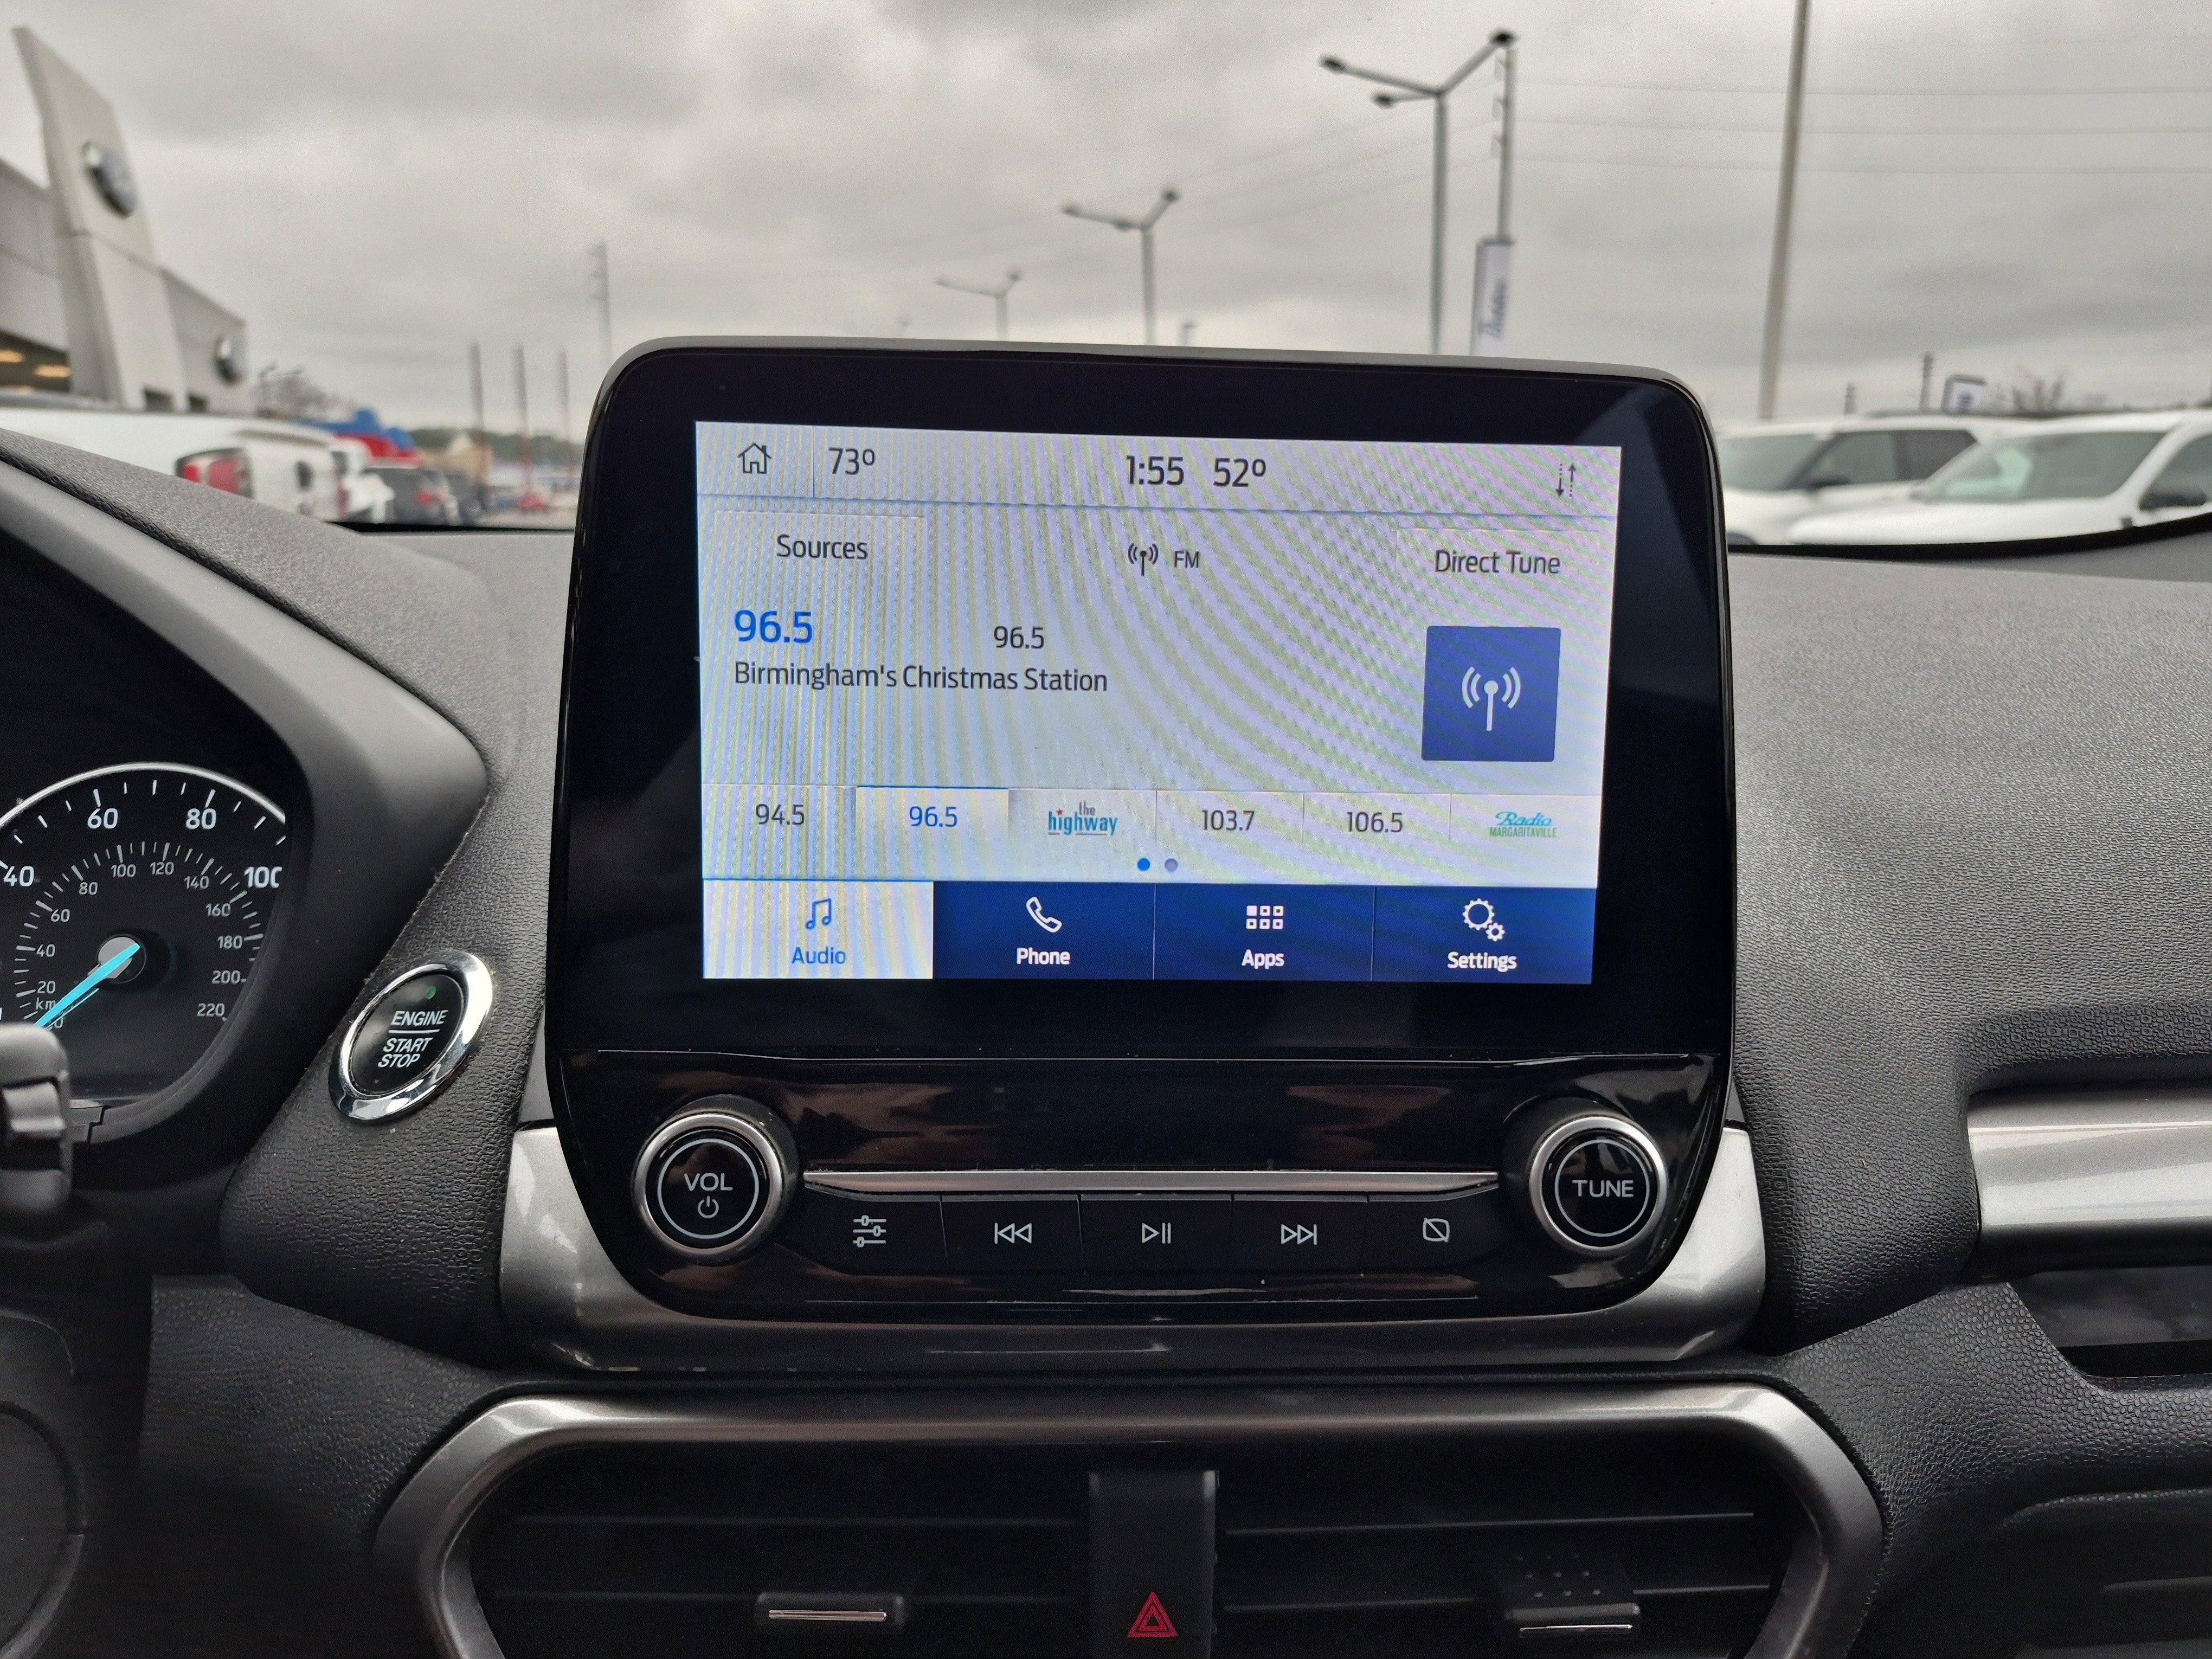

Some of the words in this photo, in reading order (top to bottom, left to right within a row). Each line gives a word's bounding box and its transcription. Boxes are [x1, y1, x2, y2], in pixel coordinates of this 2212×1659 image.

[1126, 455, 1184, 486] 1:55
[776, 533, 869, 560] Sources
[1174, 550, 1200, 568] FM
[1435, 549, 1500, 574] Direct
[1506, 550, 1561, 575] Tune
[734, 609, 813, 644] 96.5
[993, 625, 1045, 650] 96.5
[735, 661, 898, 691] Birmingham's
[903, 665, 1018, 690] Christmas
[1024, 667, 1107, 691] Station
[755, 803, 805, 826] 94.5
[909, 806, 958, 828] 96.5
[1078, 801, 1096, 815] the
[87, 808, 118, 829] 60
[185, 808, 217, 829] 80
[1048, 811, 1118, 835] highway
[1201, 809, 1255, 831] 103.7
[1346, 811, 1403, 833] 106.5
[1495, 811, 1552, 826] Radio
[1489, 827, 1557, 838] MARGARITAVILLE
[3, 865, 35, 887] 40
[111, 864, 137, 878] 100
[150, 861, 175, 876] 120
[79, 882, 98, 895] 80
[184, 876, 209, 889] 140
[50, 909, 70, 922] 60
[205, 903, 230, 917] 160
[36, 944, 56, 957] 40
[217, 935, 243, 949] 180
[791, 946, 846, 964] Audio
[1017, 947, 1071, 965] Phone
[1242, 949, 1285, 969] Apps
[1448, 951, 1517, 973] Settings
[211, 970, 241, 985] 200
[37, 980, 56, 994] 20
[197, 1002, 225, 1017] 220
[391, 1009, 448, 1026] ENGINE
[383, 1037, 433, 1052] START
[377, 1053, 421, 1068] STOP
[683, 1172, 733, 1192] VOL
[1572, 1179, 1634, 1198] TUNE
